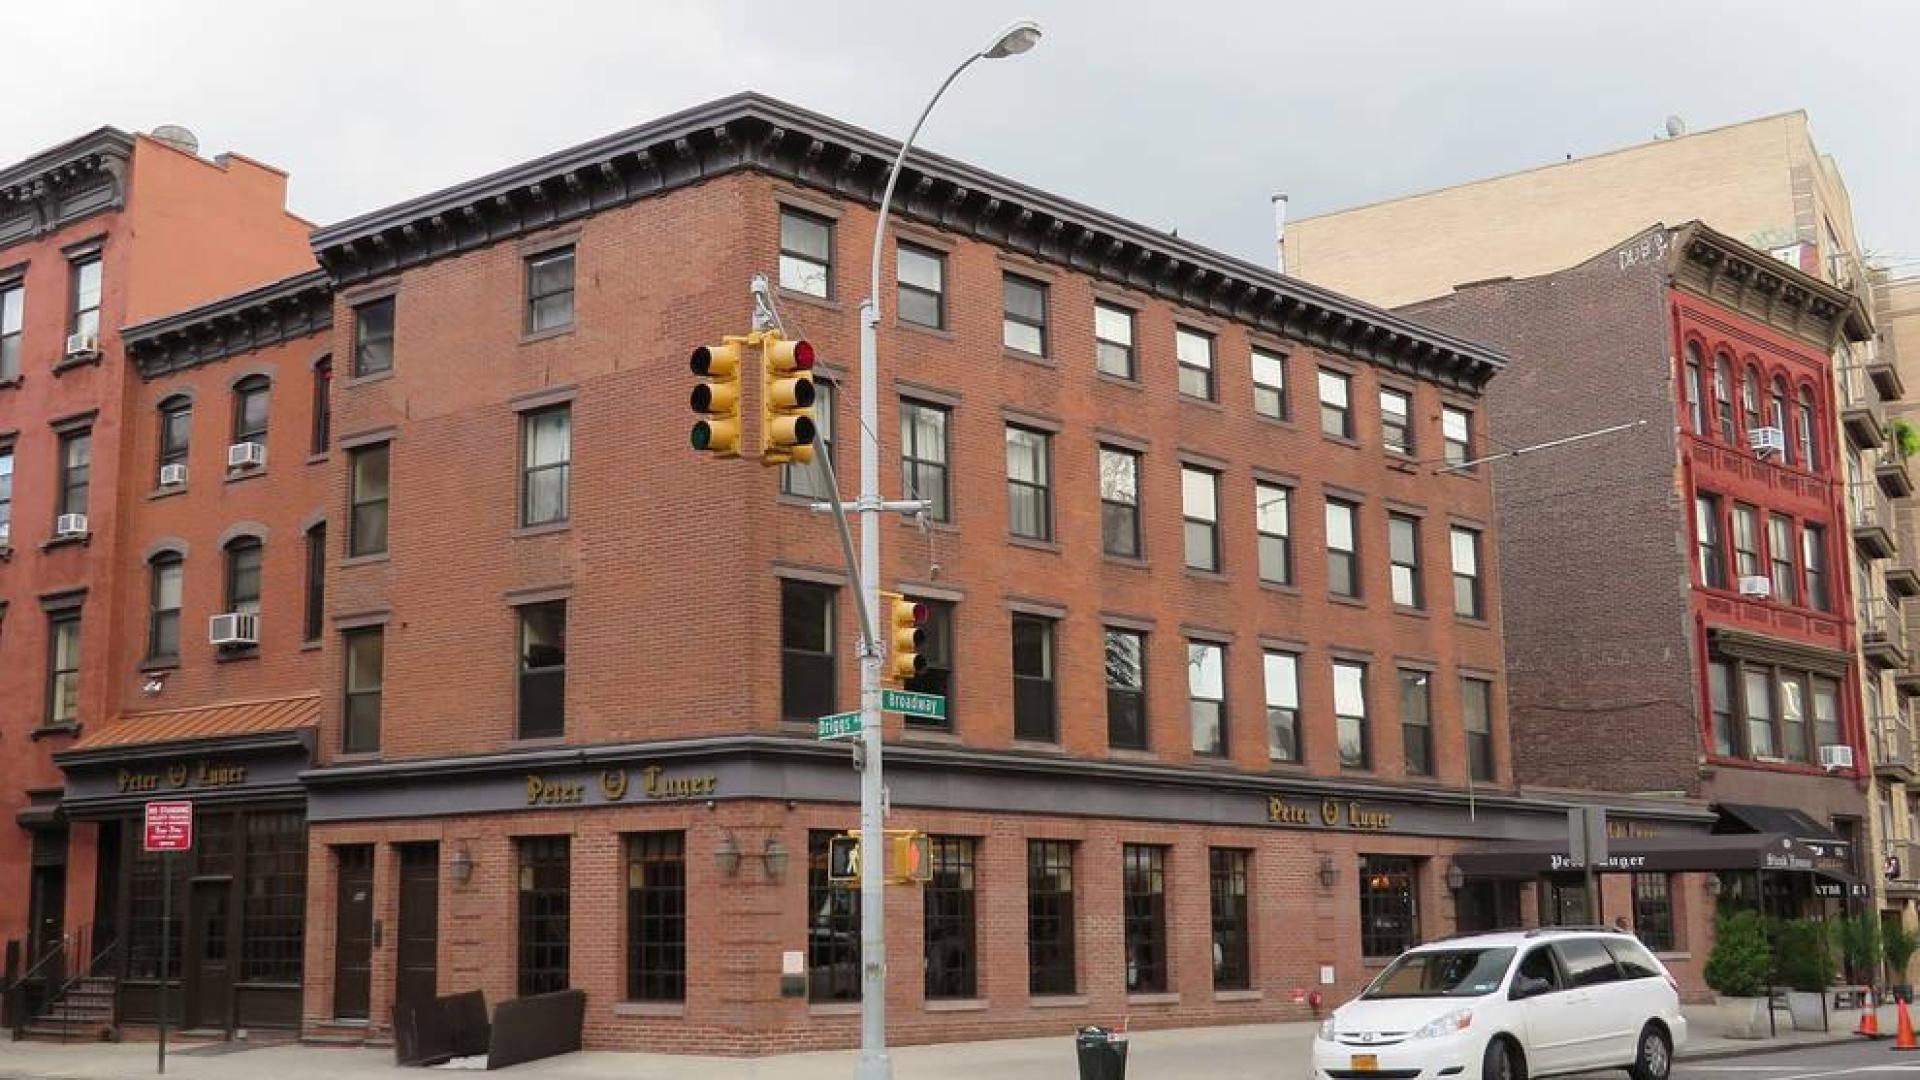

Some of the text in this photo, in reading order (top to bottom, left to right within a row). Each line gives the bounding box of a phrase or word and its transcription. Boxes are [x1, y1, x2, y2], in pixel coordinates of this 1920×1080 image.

[889, 693, 938, 715] Broadway
[819, 715, 851, 736] Driggs
[527, 765, 715, 804] Peter Luger
[1268, 796, 1392, 830] Peter Luger
[1599, 856, 1645, 870] uger
